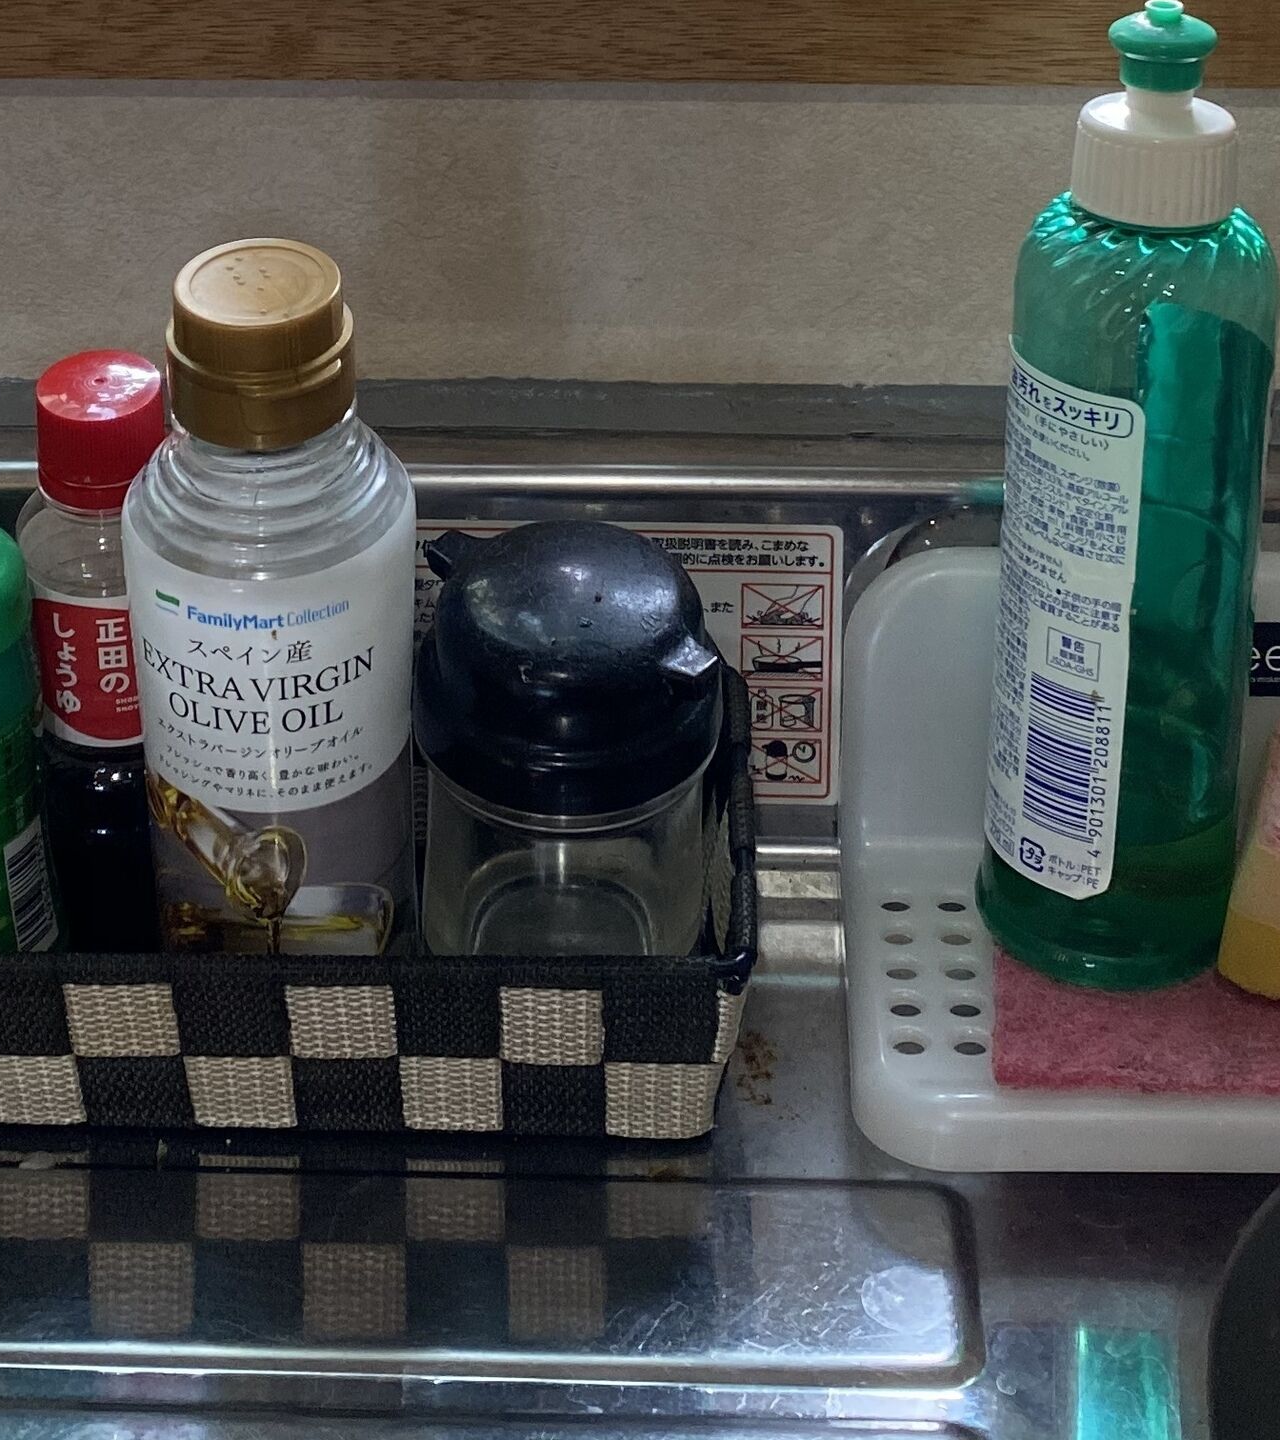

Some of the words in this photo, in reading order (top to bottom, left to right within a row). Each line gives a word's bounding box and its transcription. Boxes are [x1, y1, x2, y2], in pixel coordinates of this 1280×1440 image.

[186, 605, 285, 631] FamilyMart
[286, 600, 350, 627] Collection
[52, 612, 82, 714] しょうゆ
[95, 617, 130, 694] 正田の
[142, 636, 245, 701] EXTRA
[250, 646, 375, 703] VIRGIN
[187, 639, 313, 666] スペイン産
[169, 691, 271, 735] OLIVE
[282, 699, 344, 733] OIL
[1093, 705, 1112, 768] 208811
[1086, 776, 1108, 839] 901301
